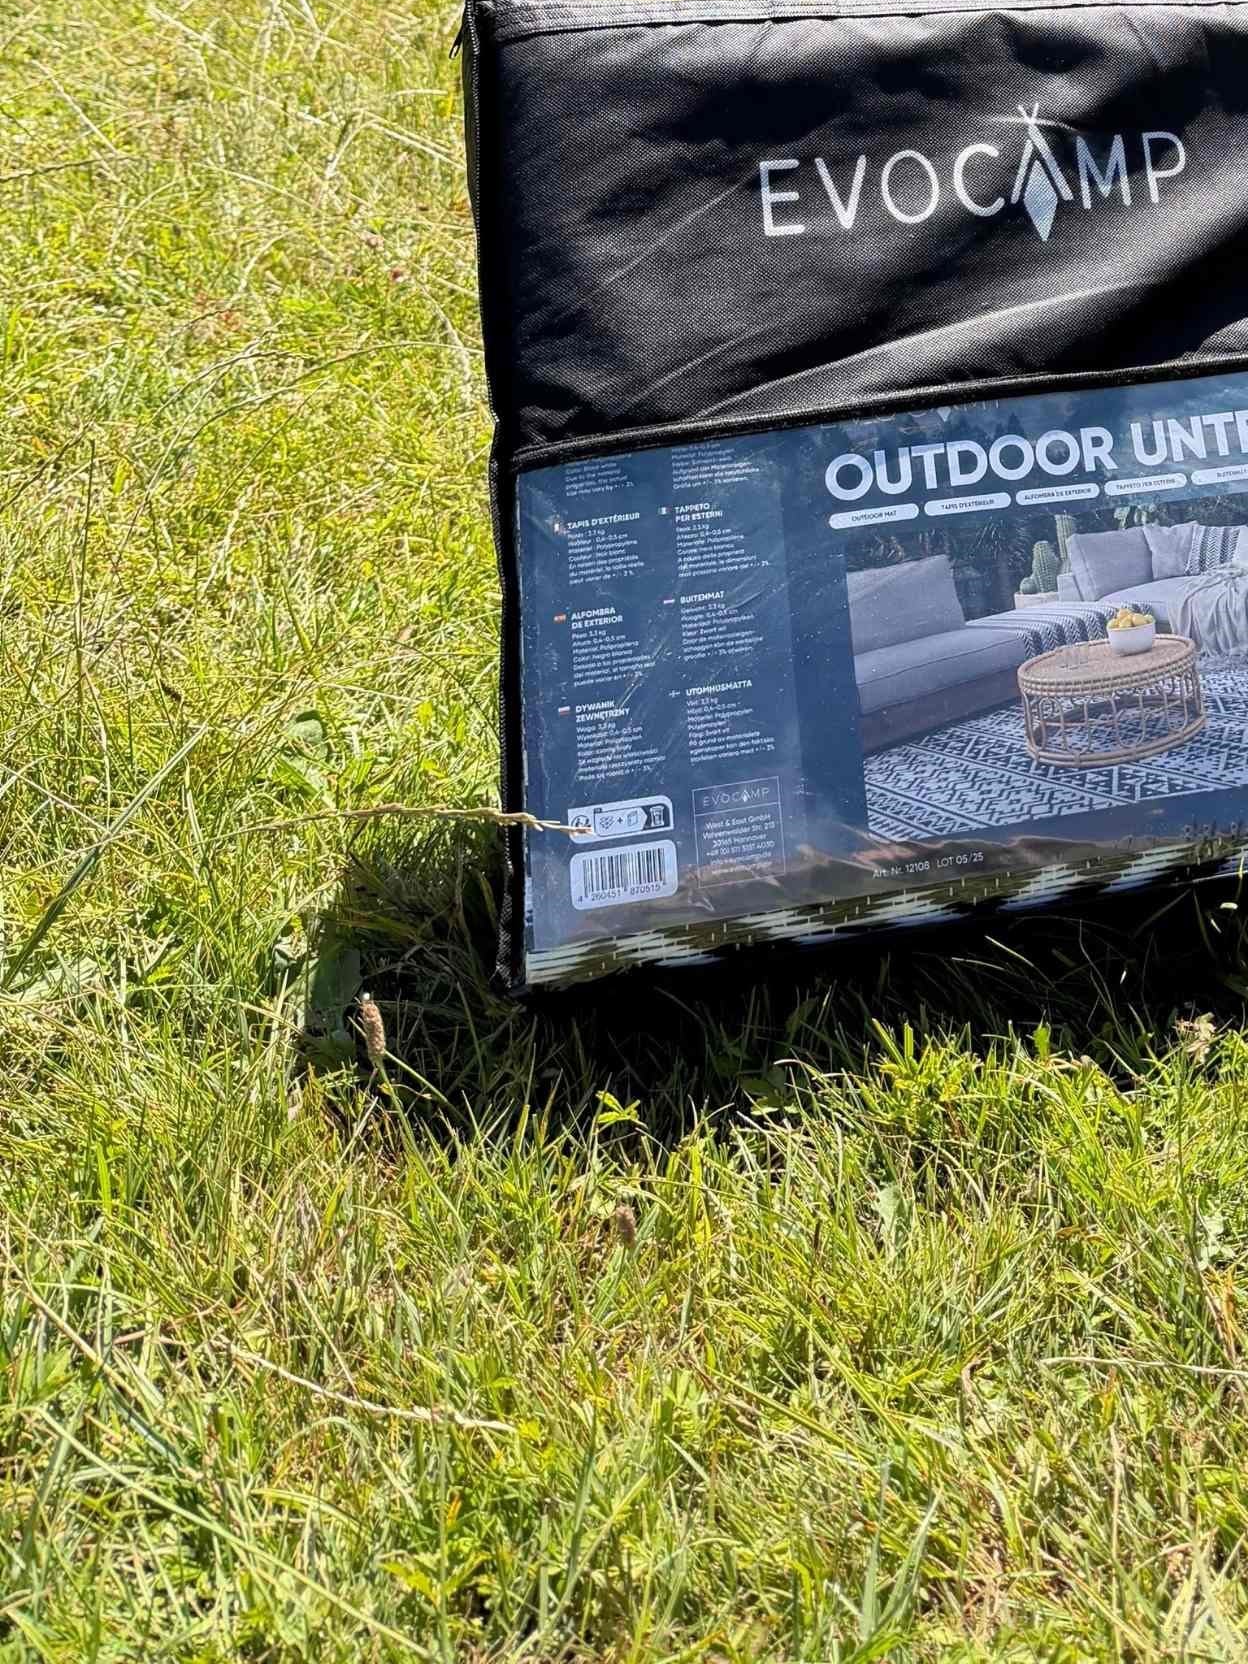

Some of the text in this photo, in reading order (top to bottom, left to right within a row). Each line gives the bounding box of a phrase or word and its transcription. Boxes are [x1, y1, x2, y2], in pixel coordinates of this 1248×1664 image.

[759, 103, 1187, 241] EVOCAMP
[824, 426, 1118, 501] OUTDOOR
[674, 503, 710, 514] TAPPETO
[885, 509, 897, 518] MAT
[675, 510, 723, 522] PER ESTERNI
[567, 519, 589, 529] TAPIS
[680, 590, 725, 604] BUITENMAT
[571, 607, 616, 620] ALFOMBRA
[571, 615, 623, 629] DE EXTERIOR
[686, 679, 752, 696] UTOMHUSMATTA
[575, 701, 615, 713] DYWANIK
[576, 708, 630, 723] ZEWNĘTRZNY
[703, 787, 769, 807] EVOCAMP
[905, 860, 930, 873] 12108
[936, 855, 954, 868] LOT
[955, 851, 984, 865] 05/25
[591, 890, 621, 901] 260451
[630, 884, 661, 895] 870515
